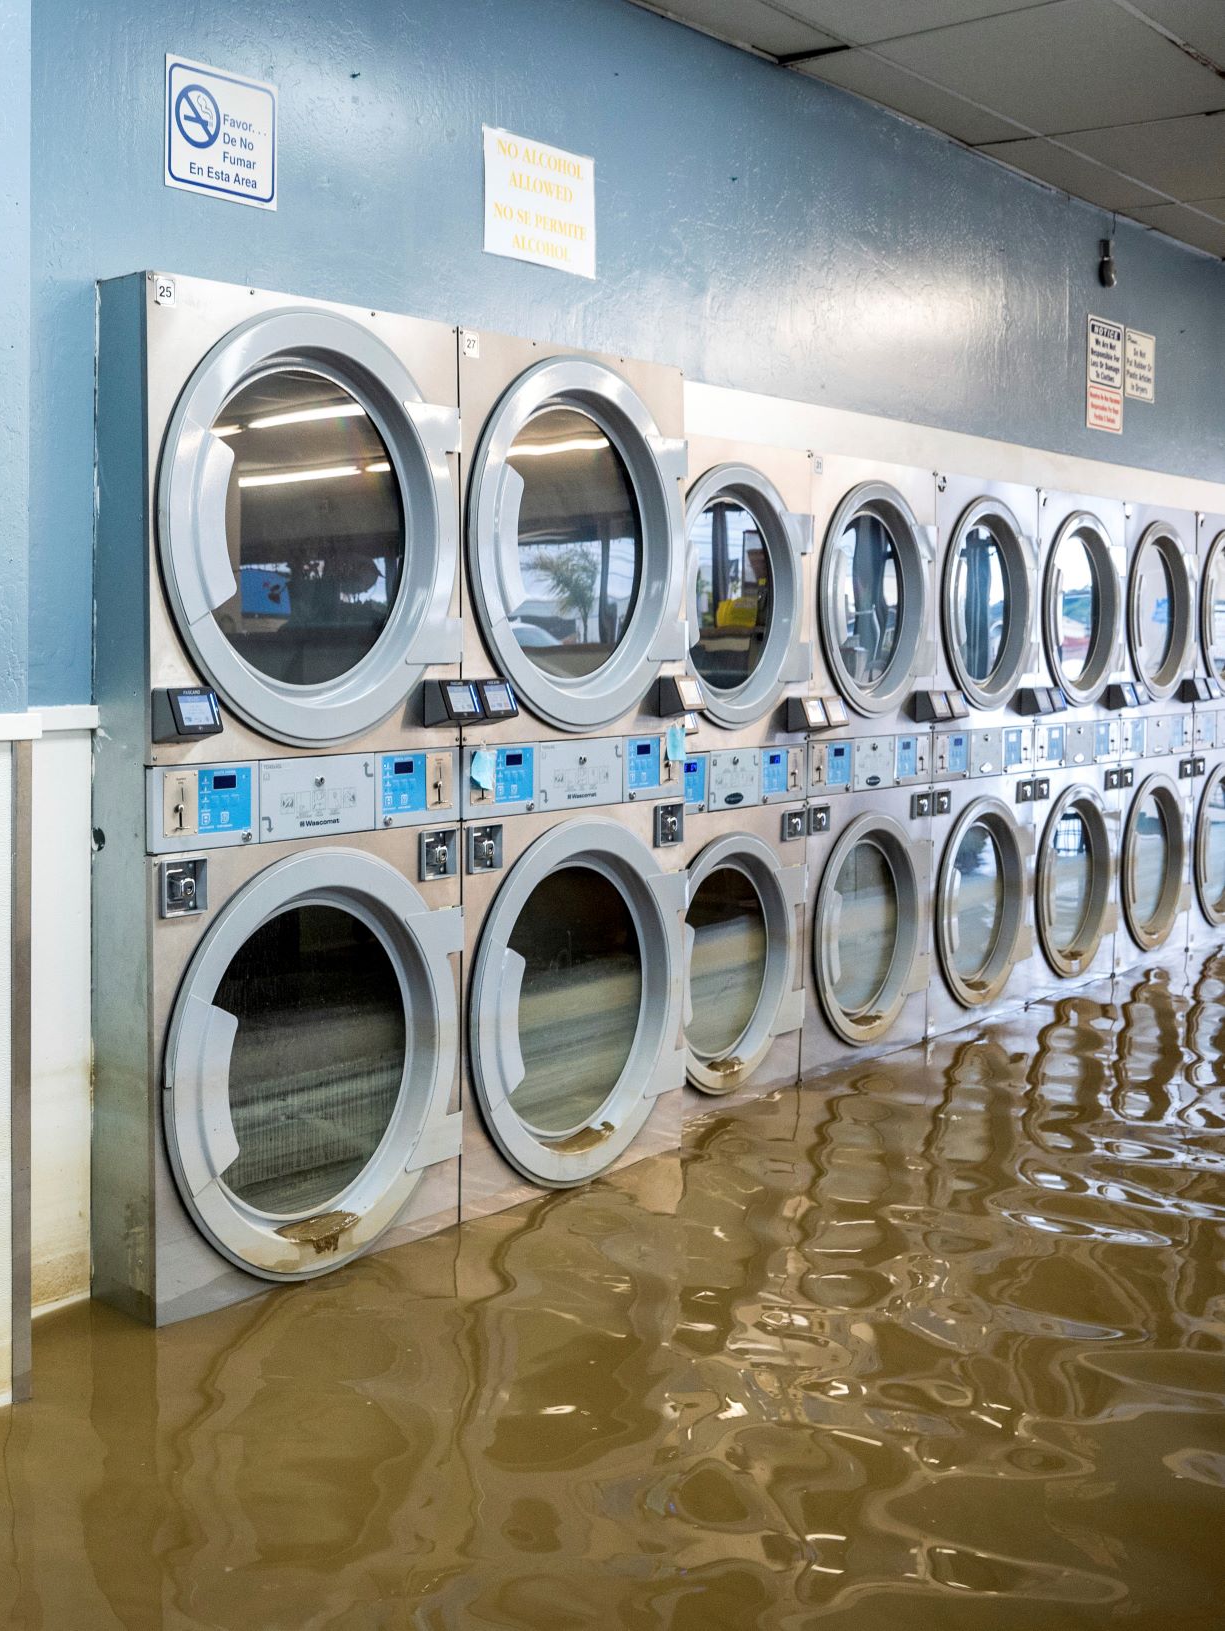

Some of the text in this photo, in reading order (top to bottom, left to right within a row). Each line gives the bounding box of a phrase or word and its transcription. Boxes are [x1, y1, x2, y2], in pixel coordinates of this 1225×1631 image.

[223, 132, 255, 151] De No
[223, 151, 256, 170] Fumar
[496, 138, 585, 181] NO ALCOHOL
[189, 161, 257, 189] En Esta Area
[508, 171, 574, 203] ALLOWED
[493, 200, 588, 241] NO SE PERMITE
[512, 233, 571, 262] ALCOHOL
[159, 286, 172, 298] 25
[1093, 325, 1118, 340] NOTICE
[466, 338, 476, 349] 27
[571, 792, 597, 800] Wascomat
[305, 817, 340, 828] Wascomat
